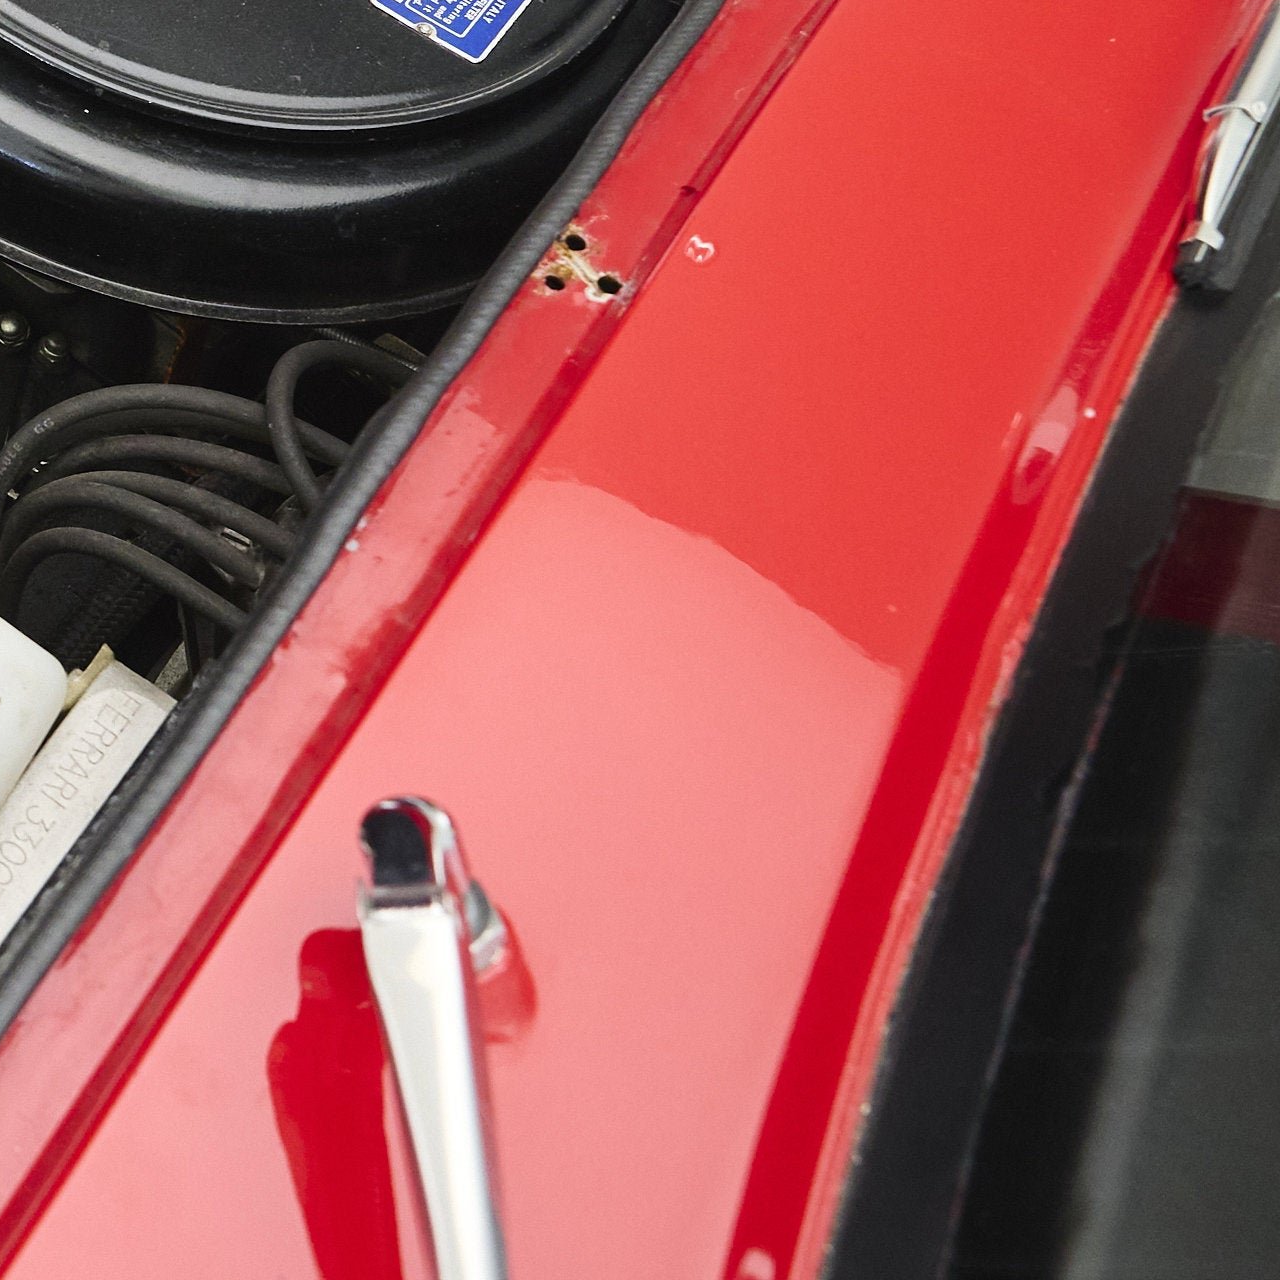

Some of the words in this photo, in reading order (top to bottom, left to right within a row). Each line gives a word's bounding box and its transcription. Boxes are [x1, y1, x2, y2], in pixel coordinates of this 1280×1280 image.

[433, 5, 446, 19] and
[483, 0, 505, 22] ITALY
[42, 690, 143, 811] FERRARI
